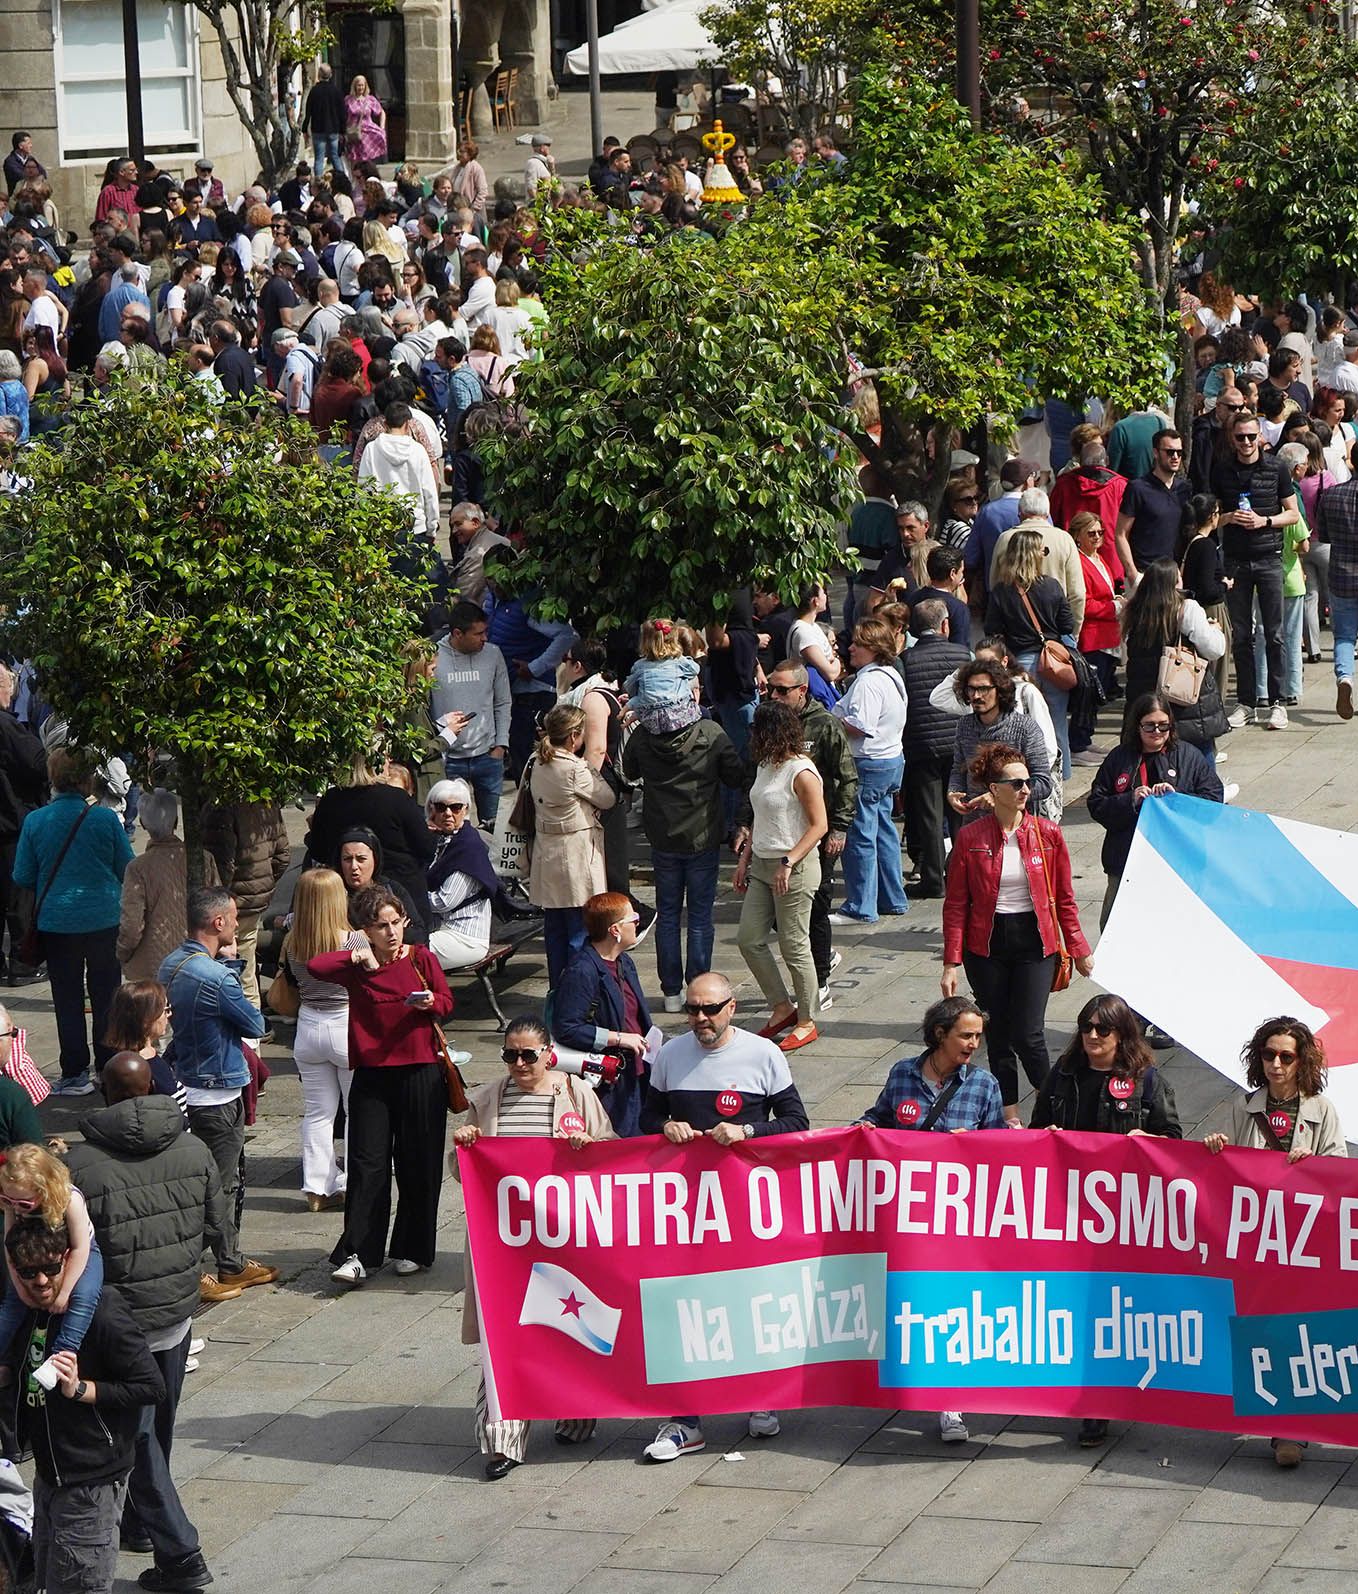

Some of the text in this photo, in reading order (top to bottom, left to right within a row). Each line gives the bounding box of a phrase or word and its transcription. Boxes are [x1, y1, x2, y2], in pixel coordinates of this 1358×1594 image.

[447, 670, 480, 683] PUMA
[504, 831, 529, 844] Trus
[500, 860, 520, 870] na
[1113, 1079, 1129, 1090] CIG
[721, 1095, 737, 1106] CIG
[902, 1104, 916, 1115] CIG
[1271, 1116, 1286, 1126] CIG
[498, 1168, 732, 1248] CONTRA
[747, 1166, 784, 1240] O
[800, 1158, 1209, 1264] IMPERIALISMO,
[1226, 1185, 1324, 1269] PAZ
[675, 1264, 880, 1365] Na Galiza,
[894, 1279, 1204, 1391] traballo digno
[1251, 1346, 1279, 1407] e
